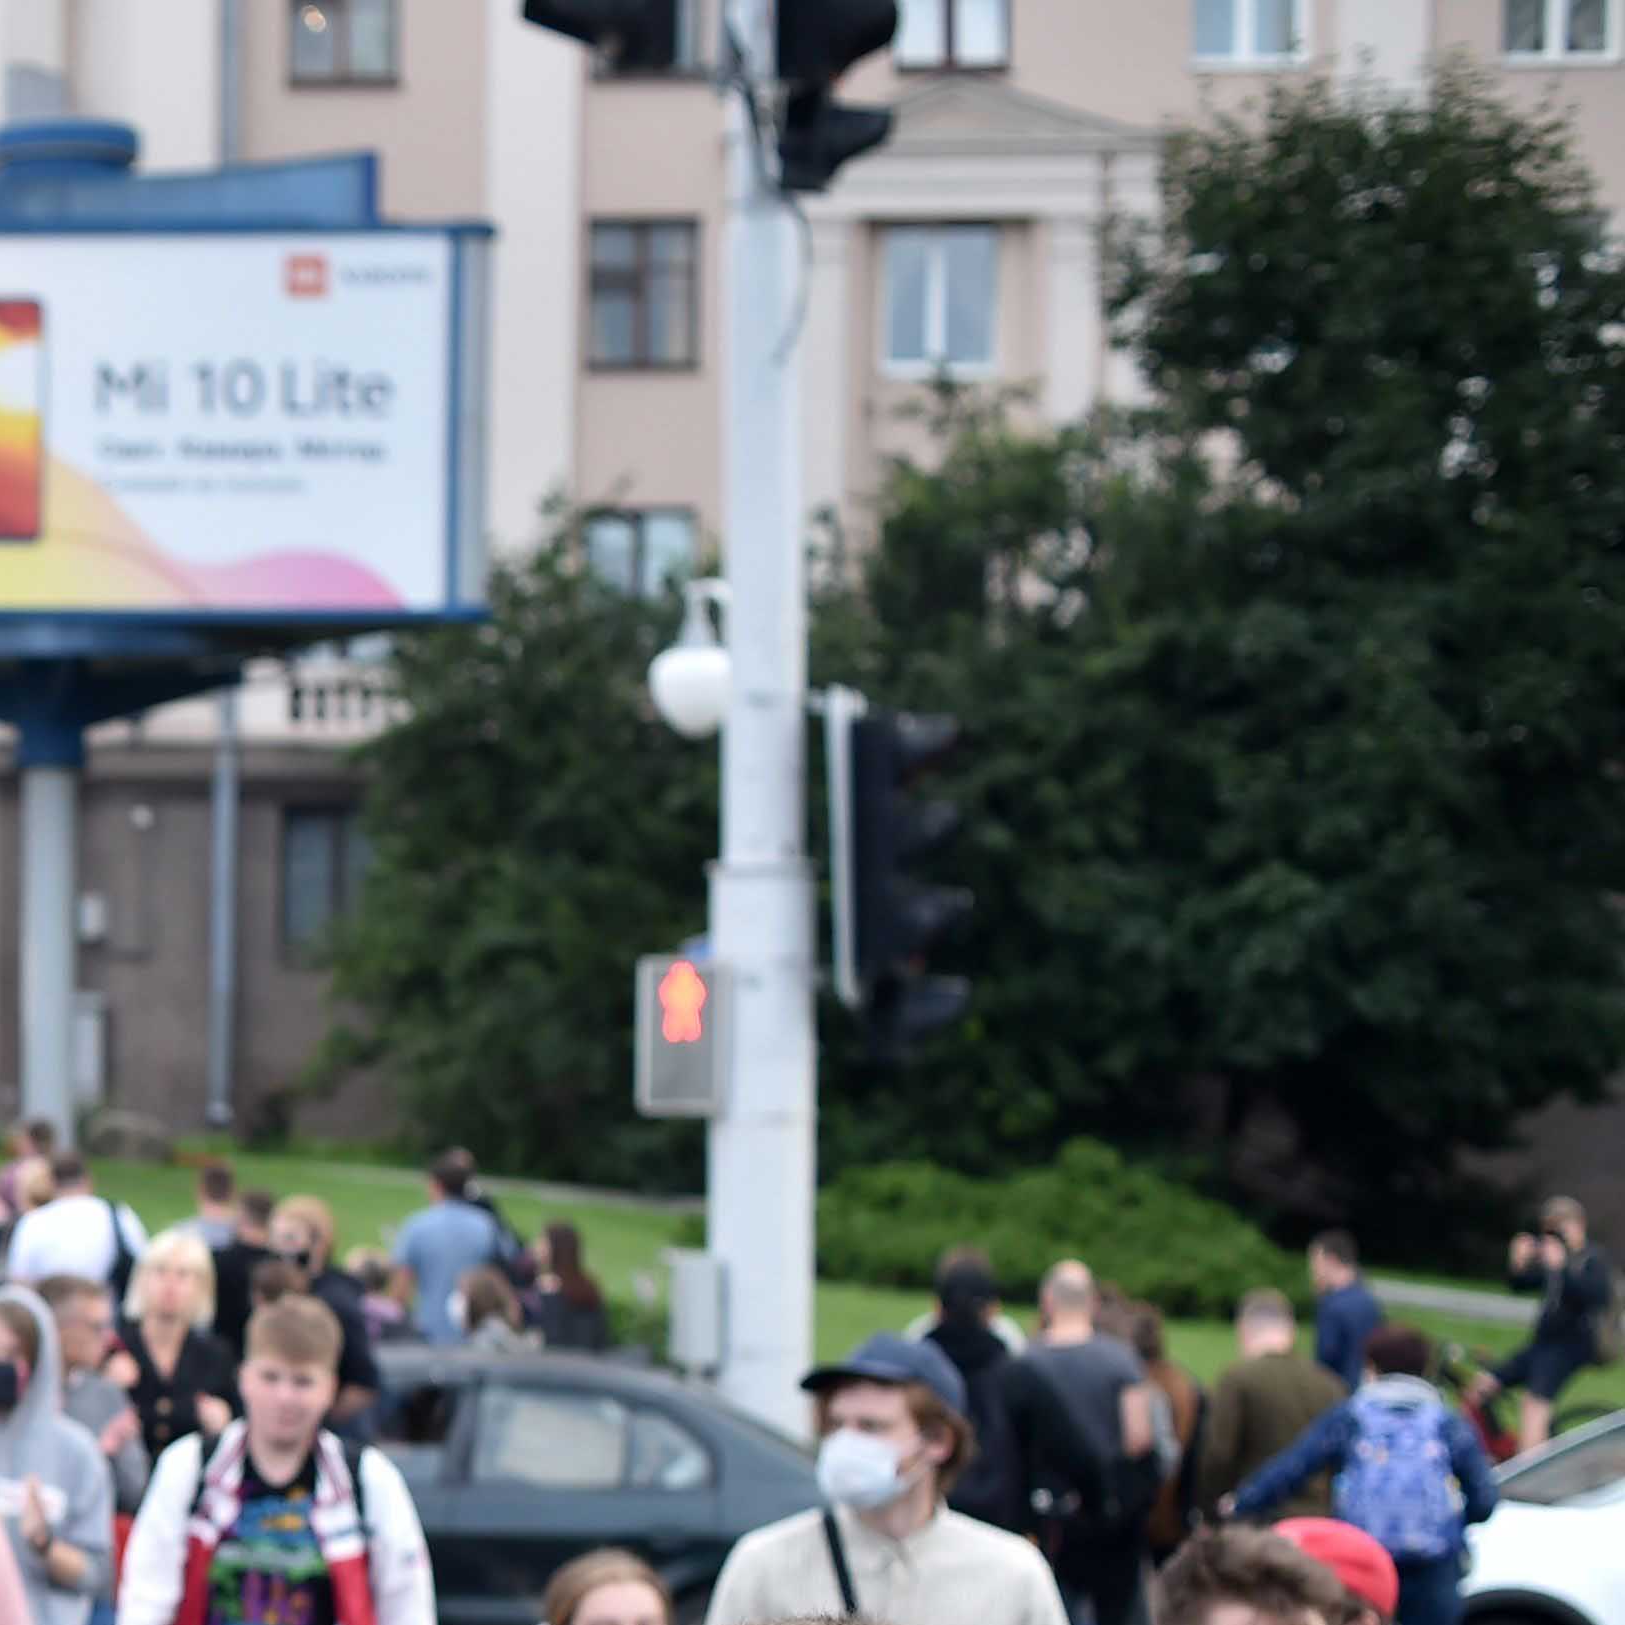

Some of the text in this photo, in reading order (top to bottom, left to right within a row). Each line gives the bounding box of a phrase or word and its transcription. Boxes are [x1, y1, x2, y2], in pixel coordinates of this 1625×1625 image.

[93, 356, 393, 416] Mi 10 Lite
